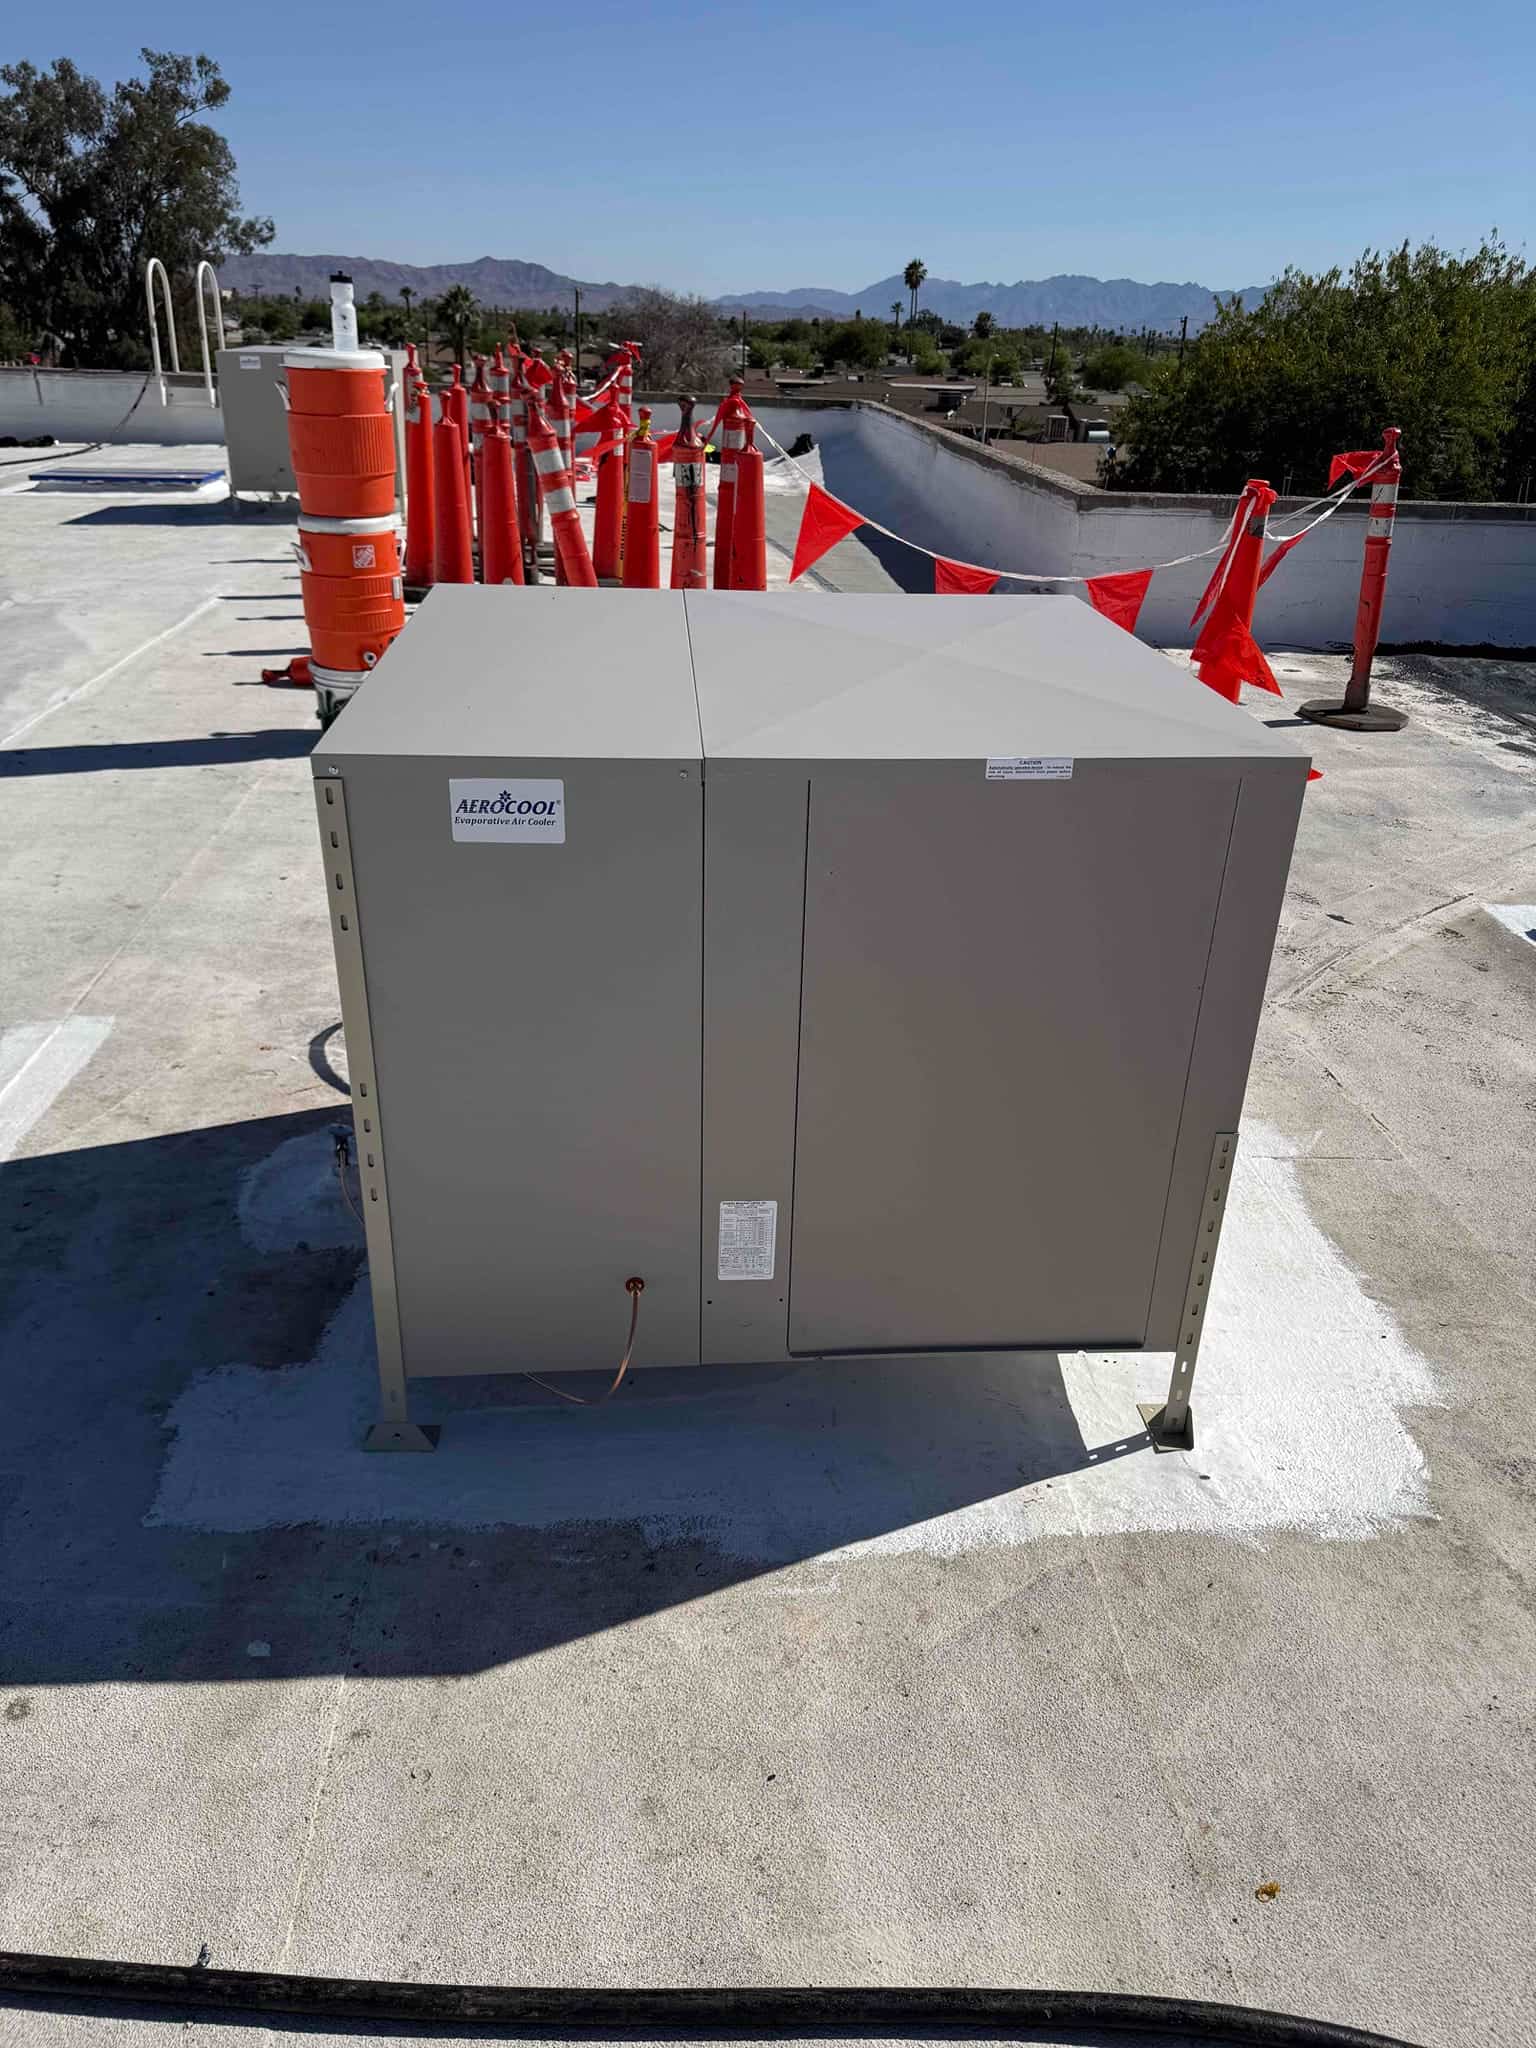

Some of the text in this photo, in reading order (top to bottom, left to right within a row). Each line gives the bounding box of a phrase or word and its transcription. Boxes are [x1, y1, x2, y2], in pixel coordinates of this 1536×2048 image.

[455, 816, 557, 827] Evaporative Air Cooler
